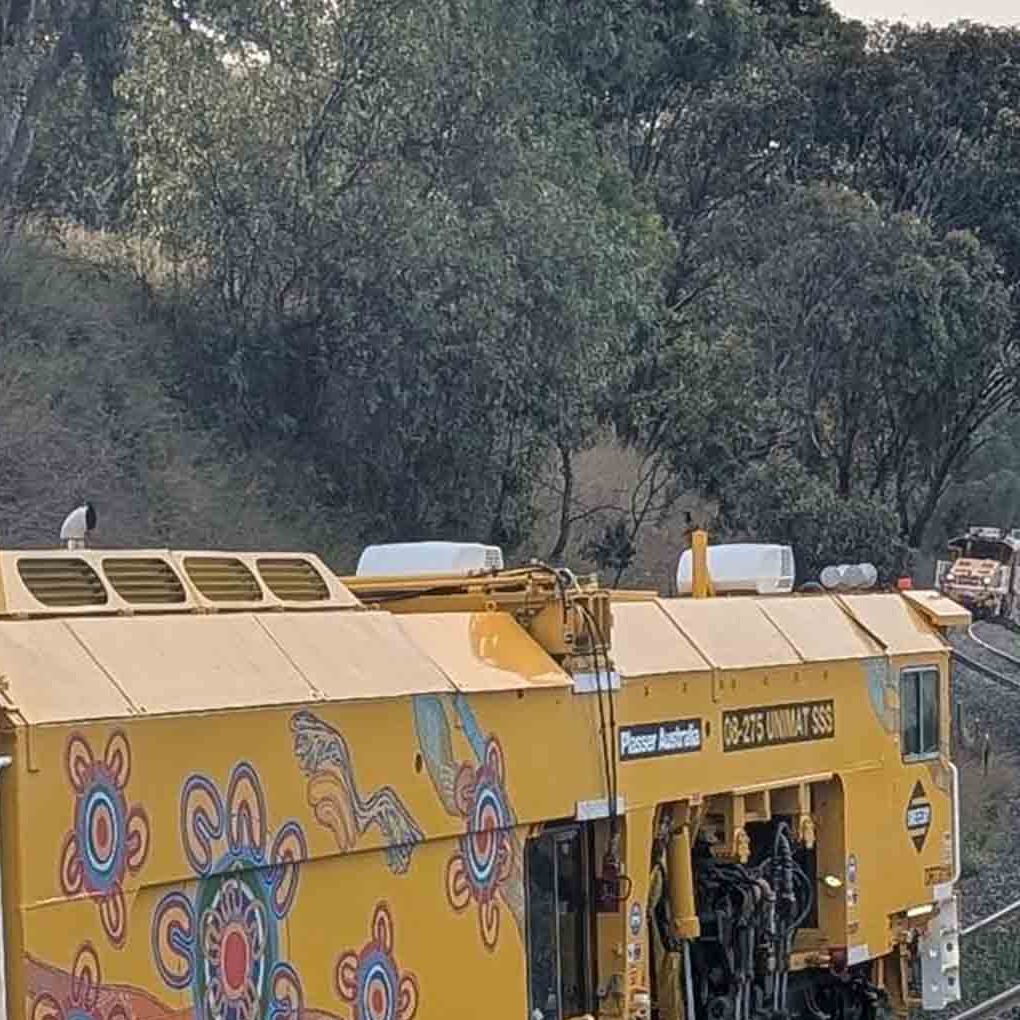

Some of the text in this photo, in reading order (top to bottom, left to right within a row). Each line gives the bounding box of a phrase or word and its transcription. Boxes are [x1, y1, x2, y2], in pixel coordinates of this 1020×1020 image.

[766, 706, 811, 739] UNIMAT
[621, 723, 701, 756] Plasser Australia
